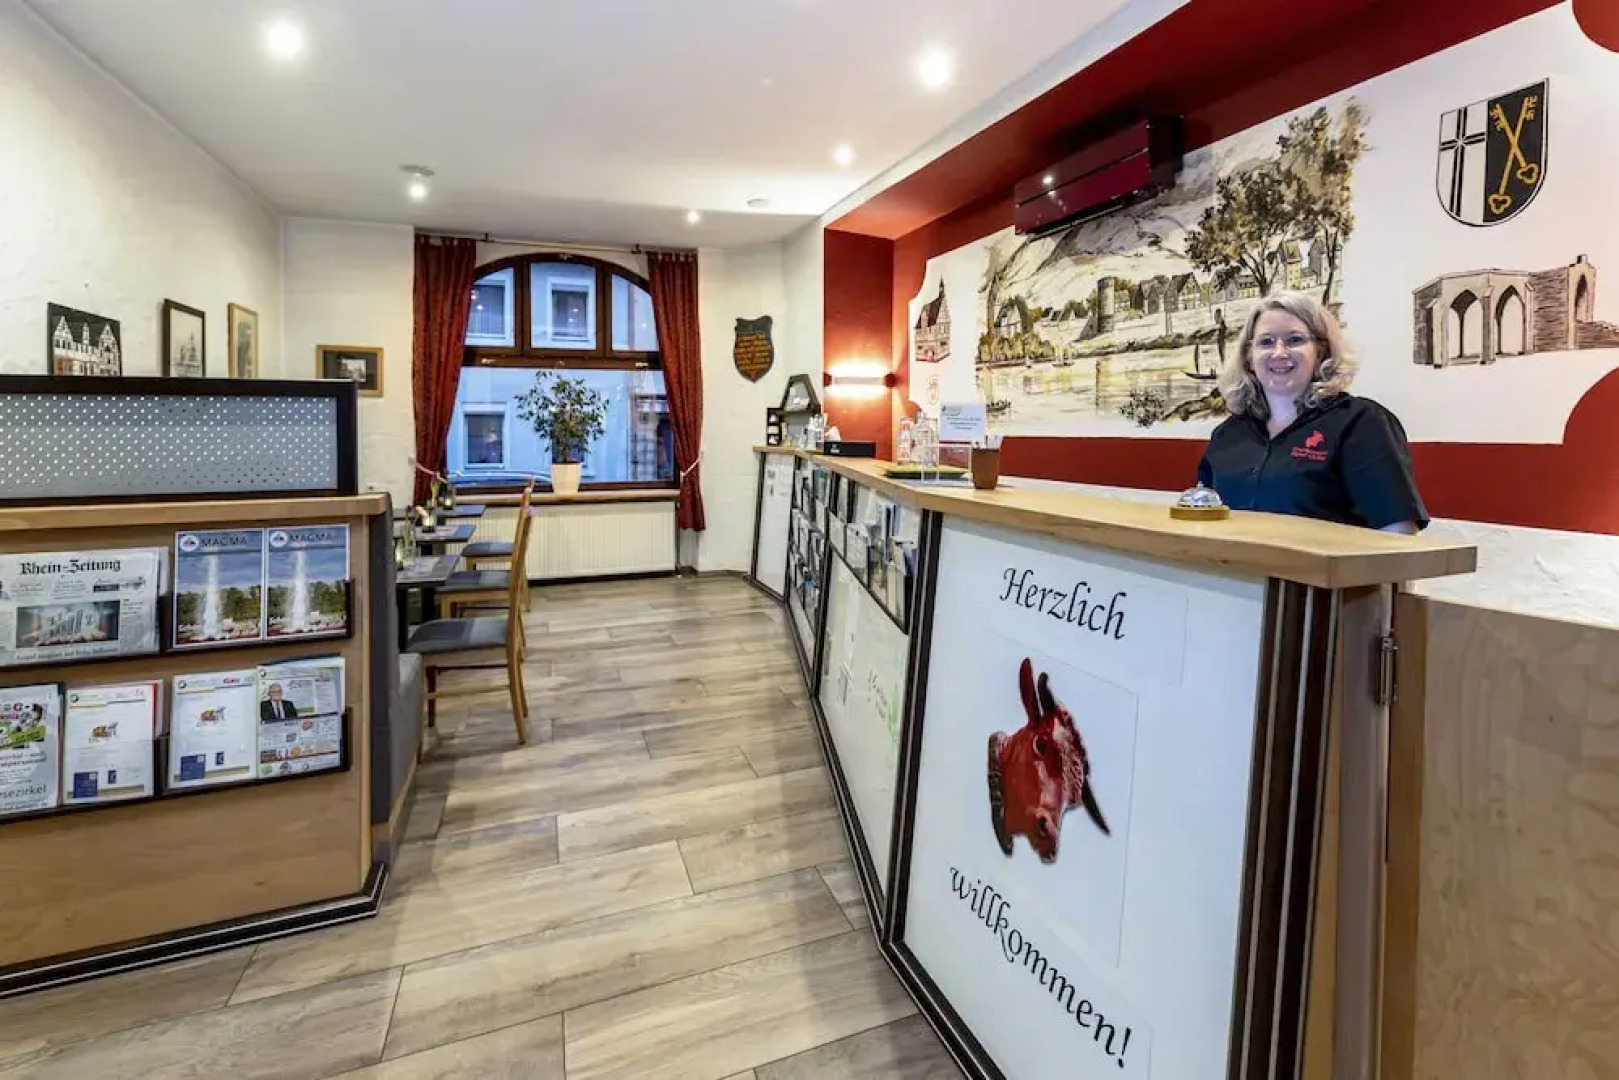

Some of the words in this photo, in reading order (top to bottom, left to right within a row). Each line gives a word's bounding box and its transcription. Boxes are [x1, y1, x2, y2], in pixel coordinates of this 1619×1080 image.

[200, 536, 247, 548] MAGMA
[289, 532, 333, 543] MAGMA
[19, 558, 121, 576] Rhein-Zeitung
[999, 566, 1127, 640] Herzlich
[949, 865, 1134, 1069] willkommen!
